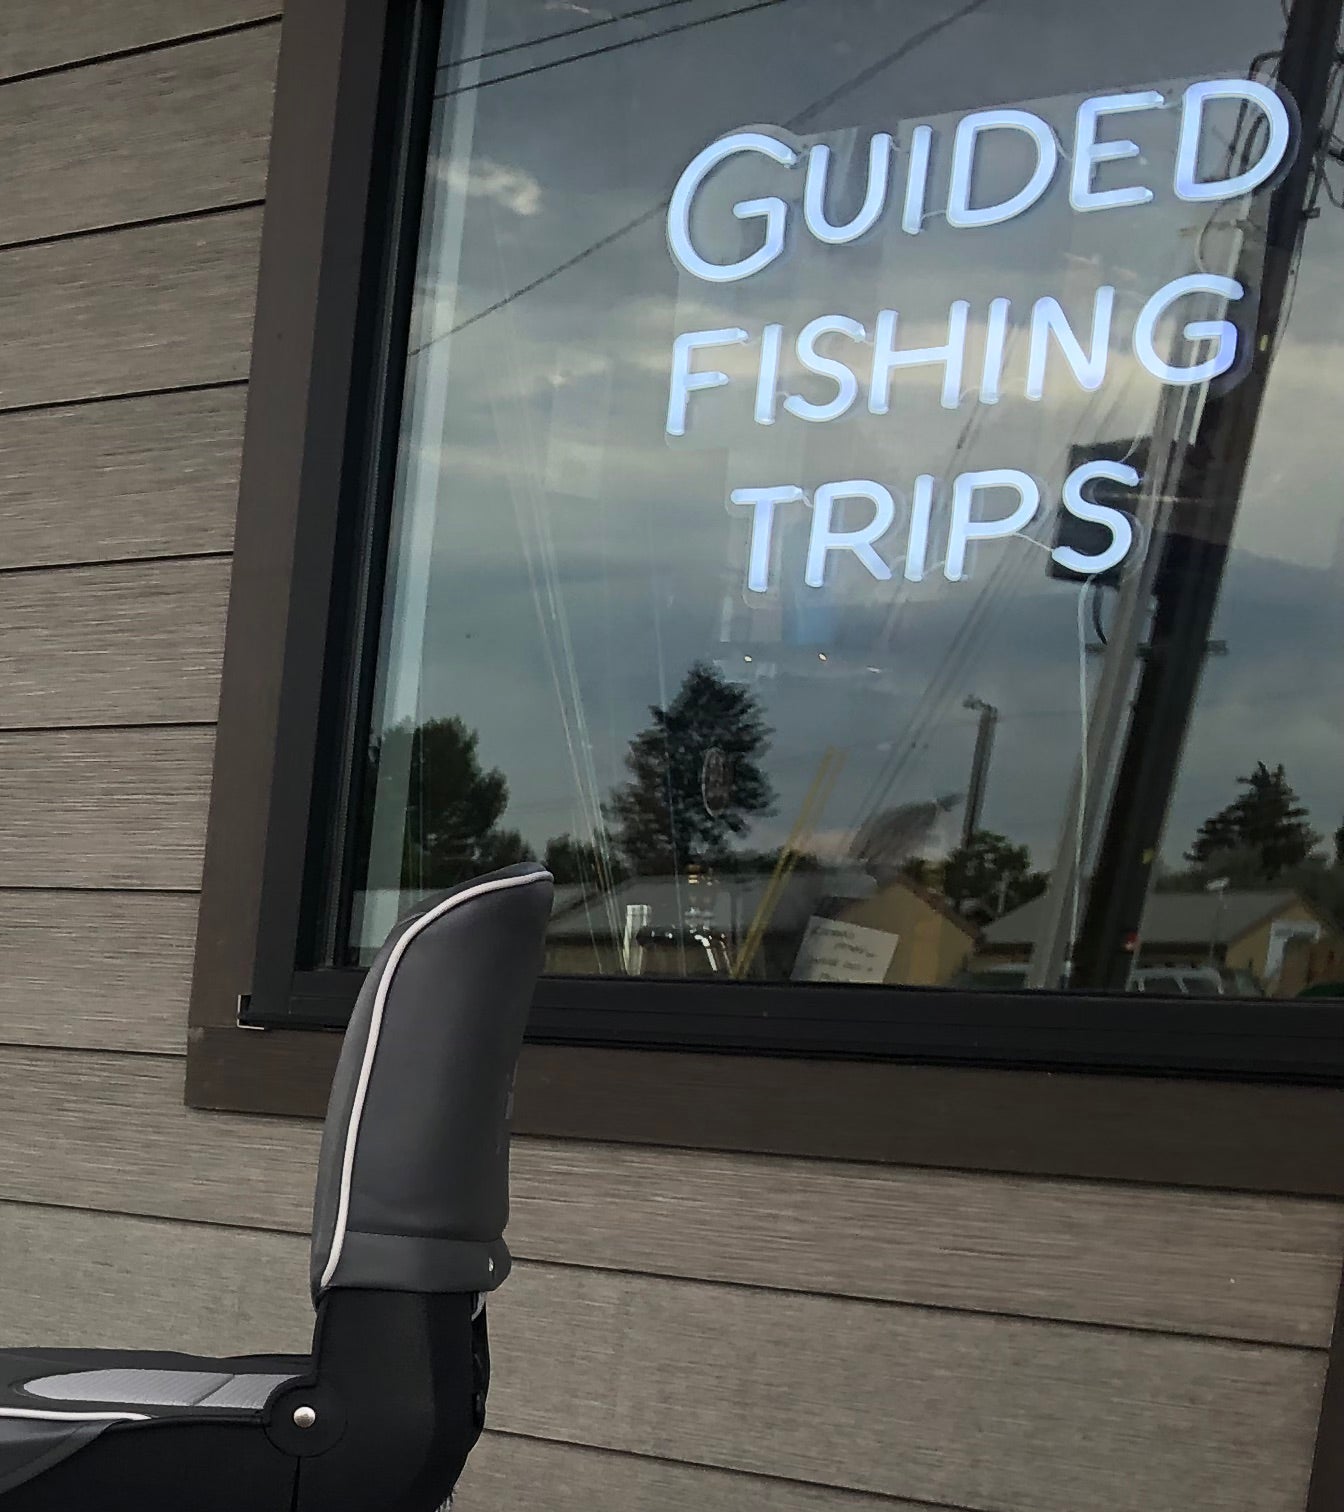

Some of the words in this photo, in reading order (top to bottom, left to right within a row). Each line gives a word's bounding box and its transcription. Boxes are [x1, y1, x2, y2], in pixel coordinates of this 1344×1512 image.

[666, 78, 1291, 283] GUIDED
[665, 273, 1244, 436] FISHING
[730, 459, 1141, 594] TRIPS
